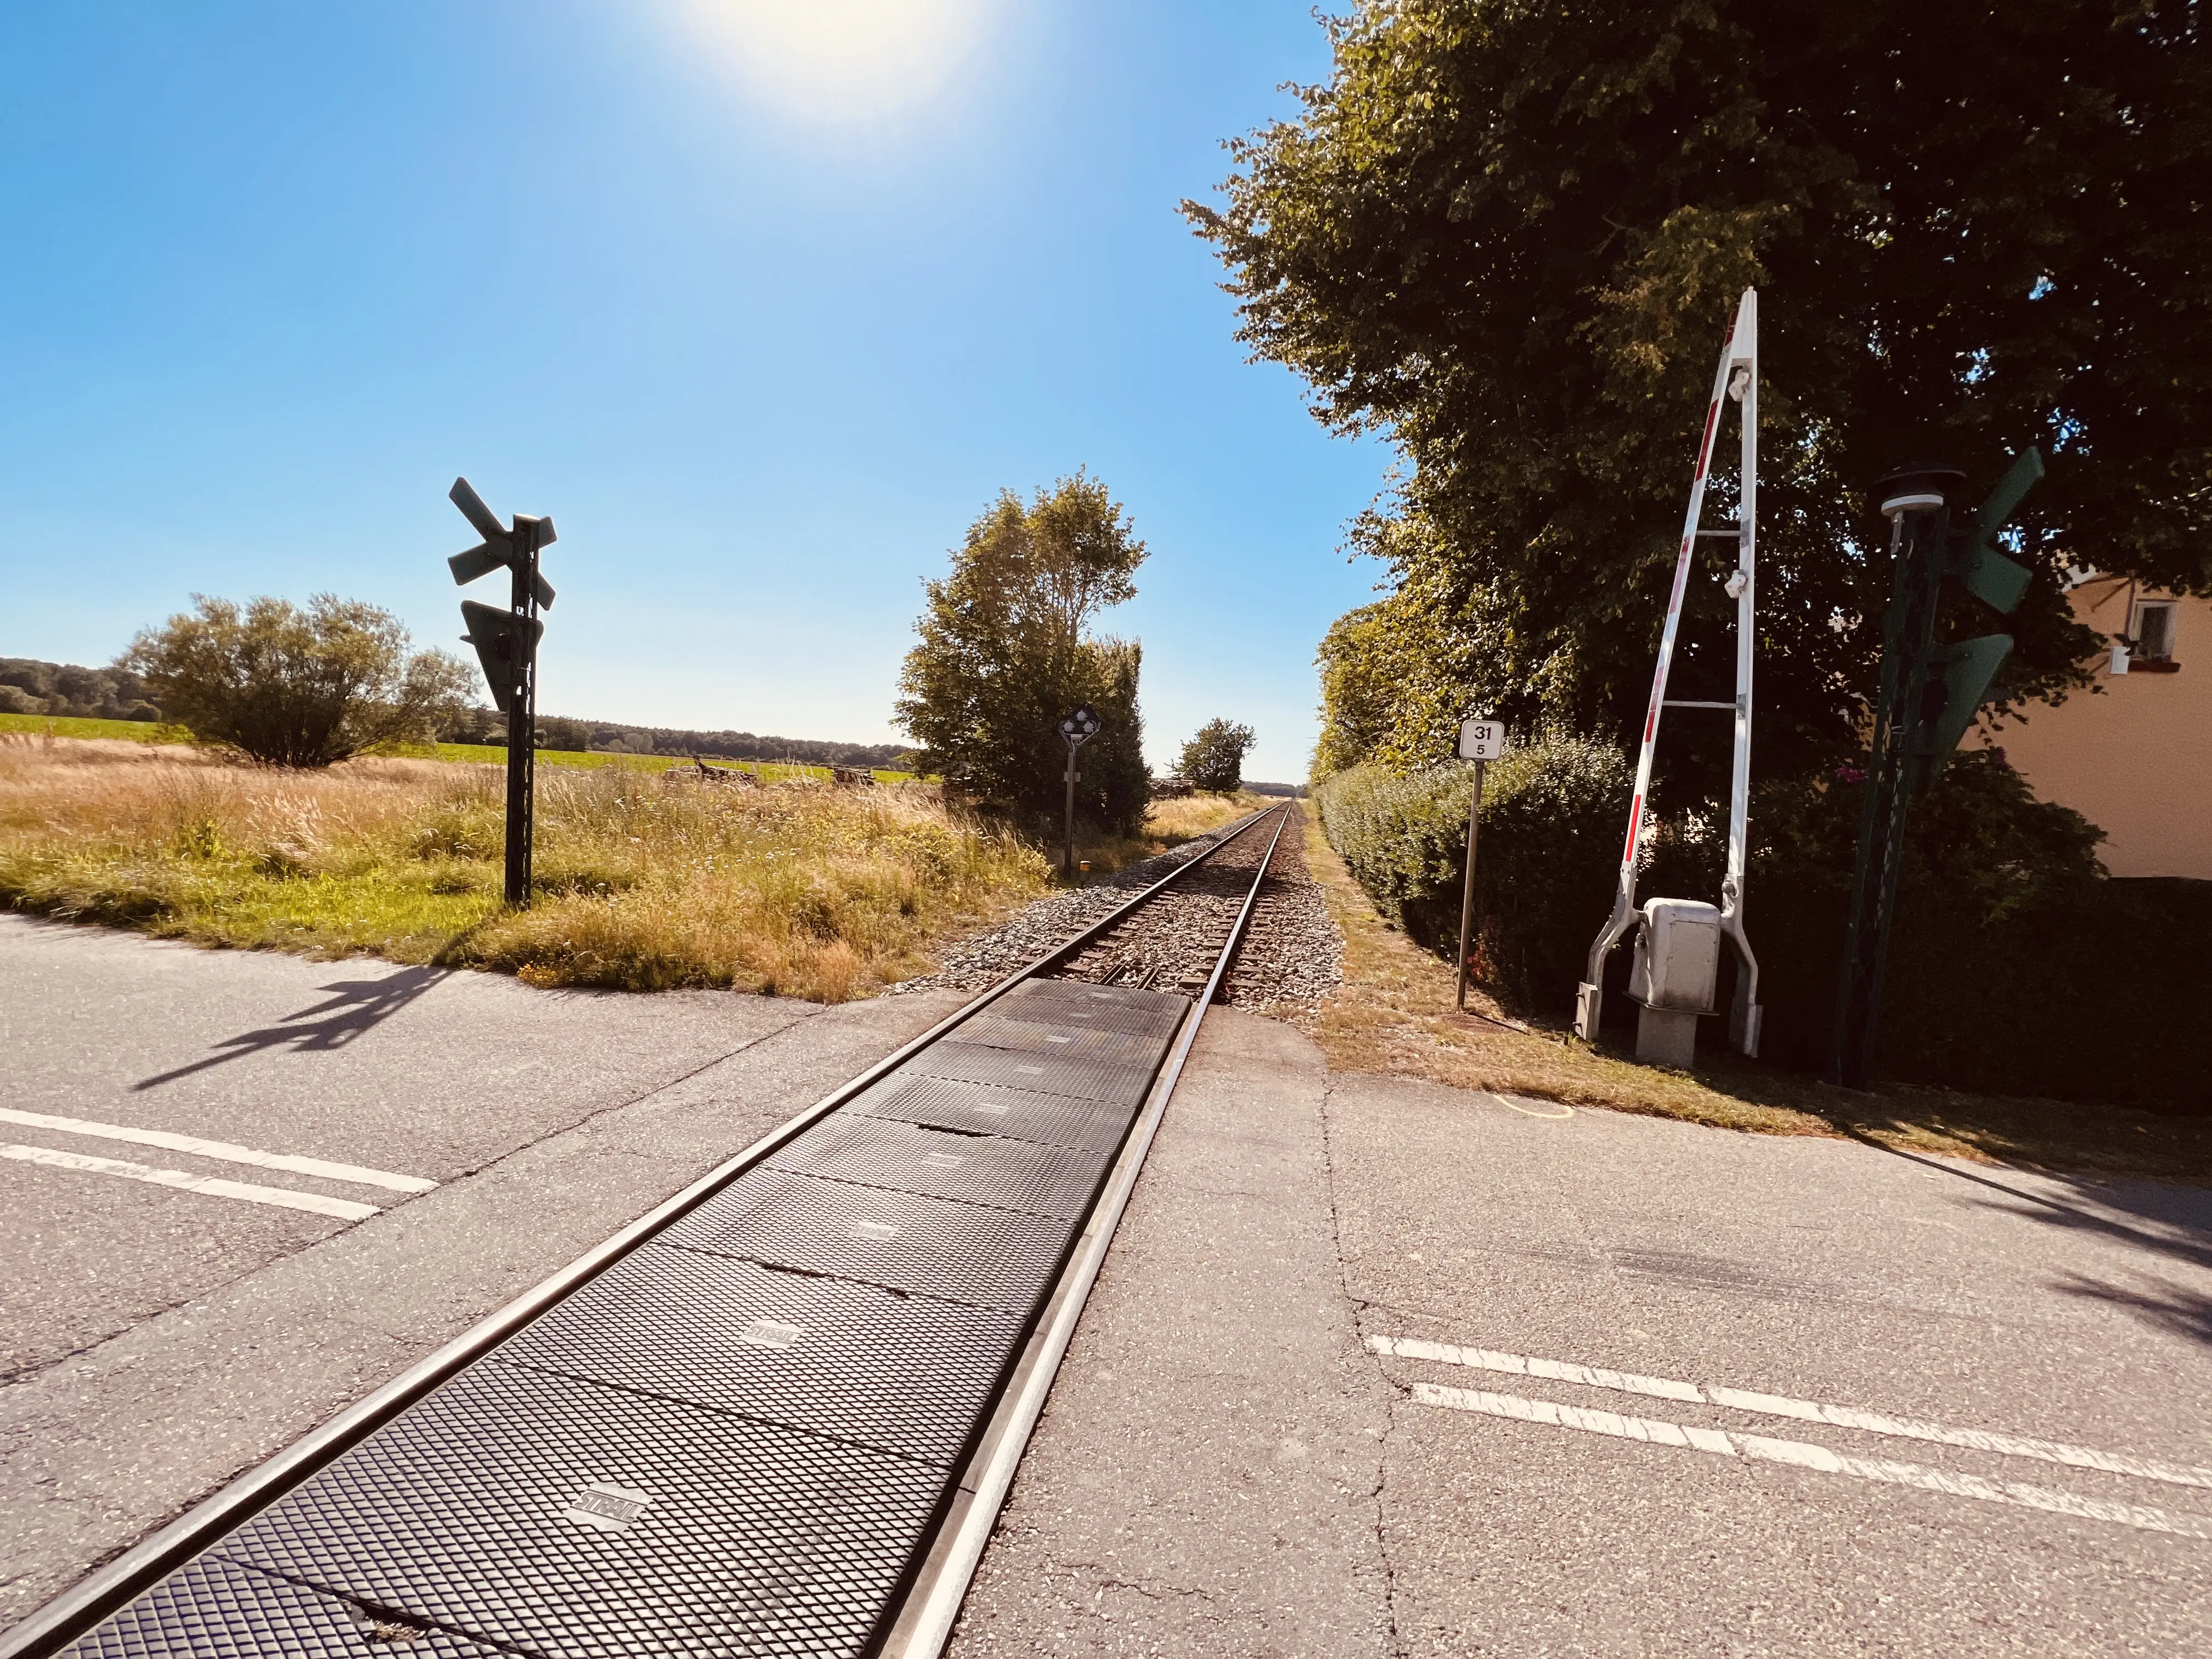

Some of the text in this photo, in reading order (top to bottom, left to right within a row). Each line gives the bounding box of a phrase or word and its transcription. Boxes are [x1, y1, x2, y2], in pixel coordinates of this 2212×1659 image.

[1474, 726, 1492, 740] 31
[1476, 744, 1485, 754] 5
[574, 1492, 638, 1520] STRAIL
